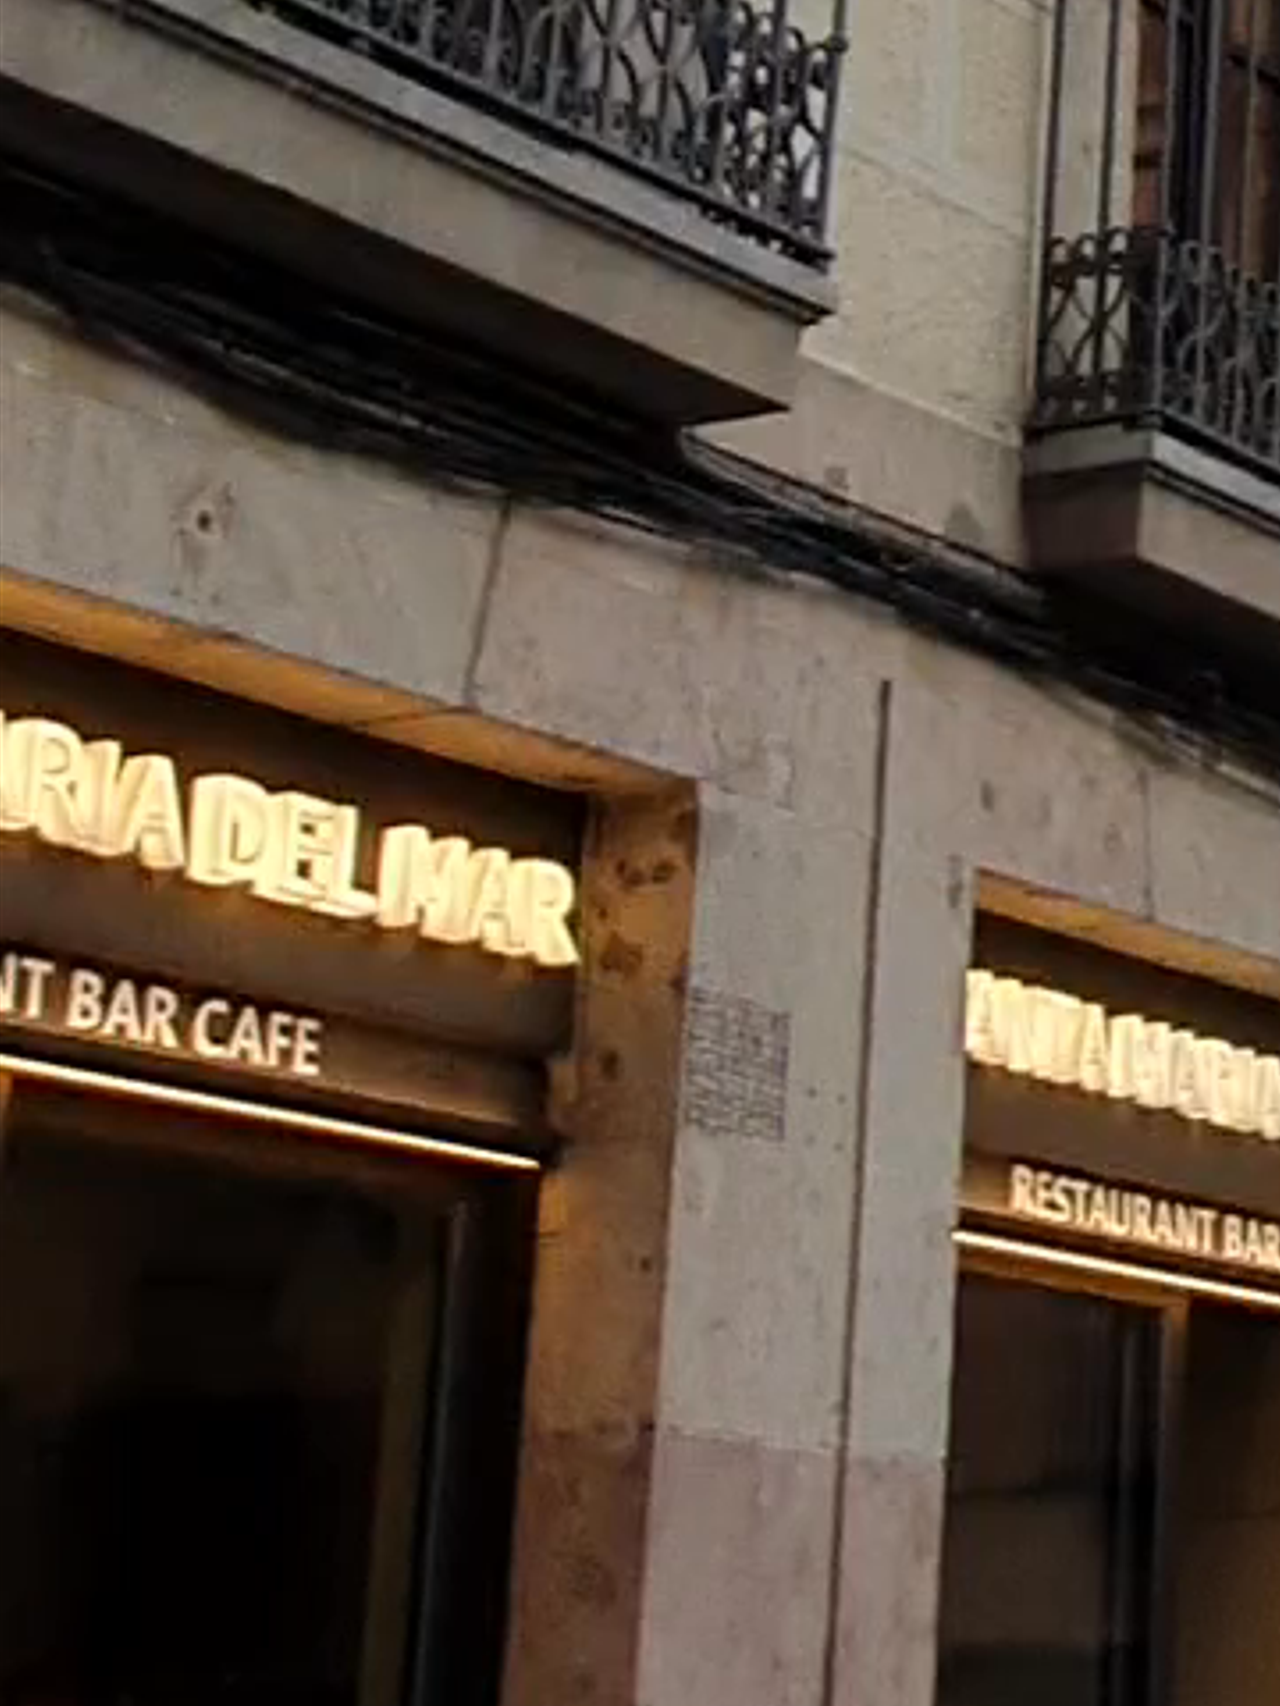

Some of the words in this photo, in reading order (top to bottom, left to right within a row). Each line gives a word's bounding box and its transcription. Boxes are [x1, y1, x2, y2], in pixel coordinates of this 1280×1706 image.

[185, 774, 378, 919] DEL
[376, 825, 581, 966] MAR
[66, 968, 180, 1049] BAR
[192, 998, 323, 1078] CAFE
[965, 969, 1109, 1091] ANTA
[1010, 1164, 1217, 1253] RESTAURANT
